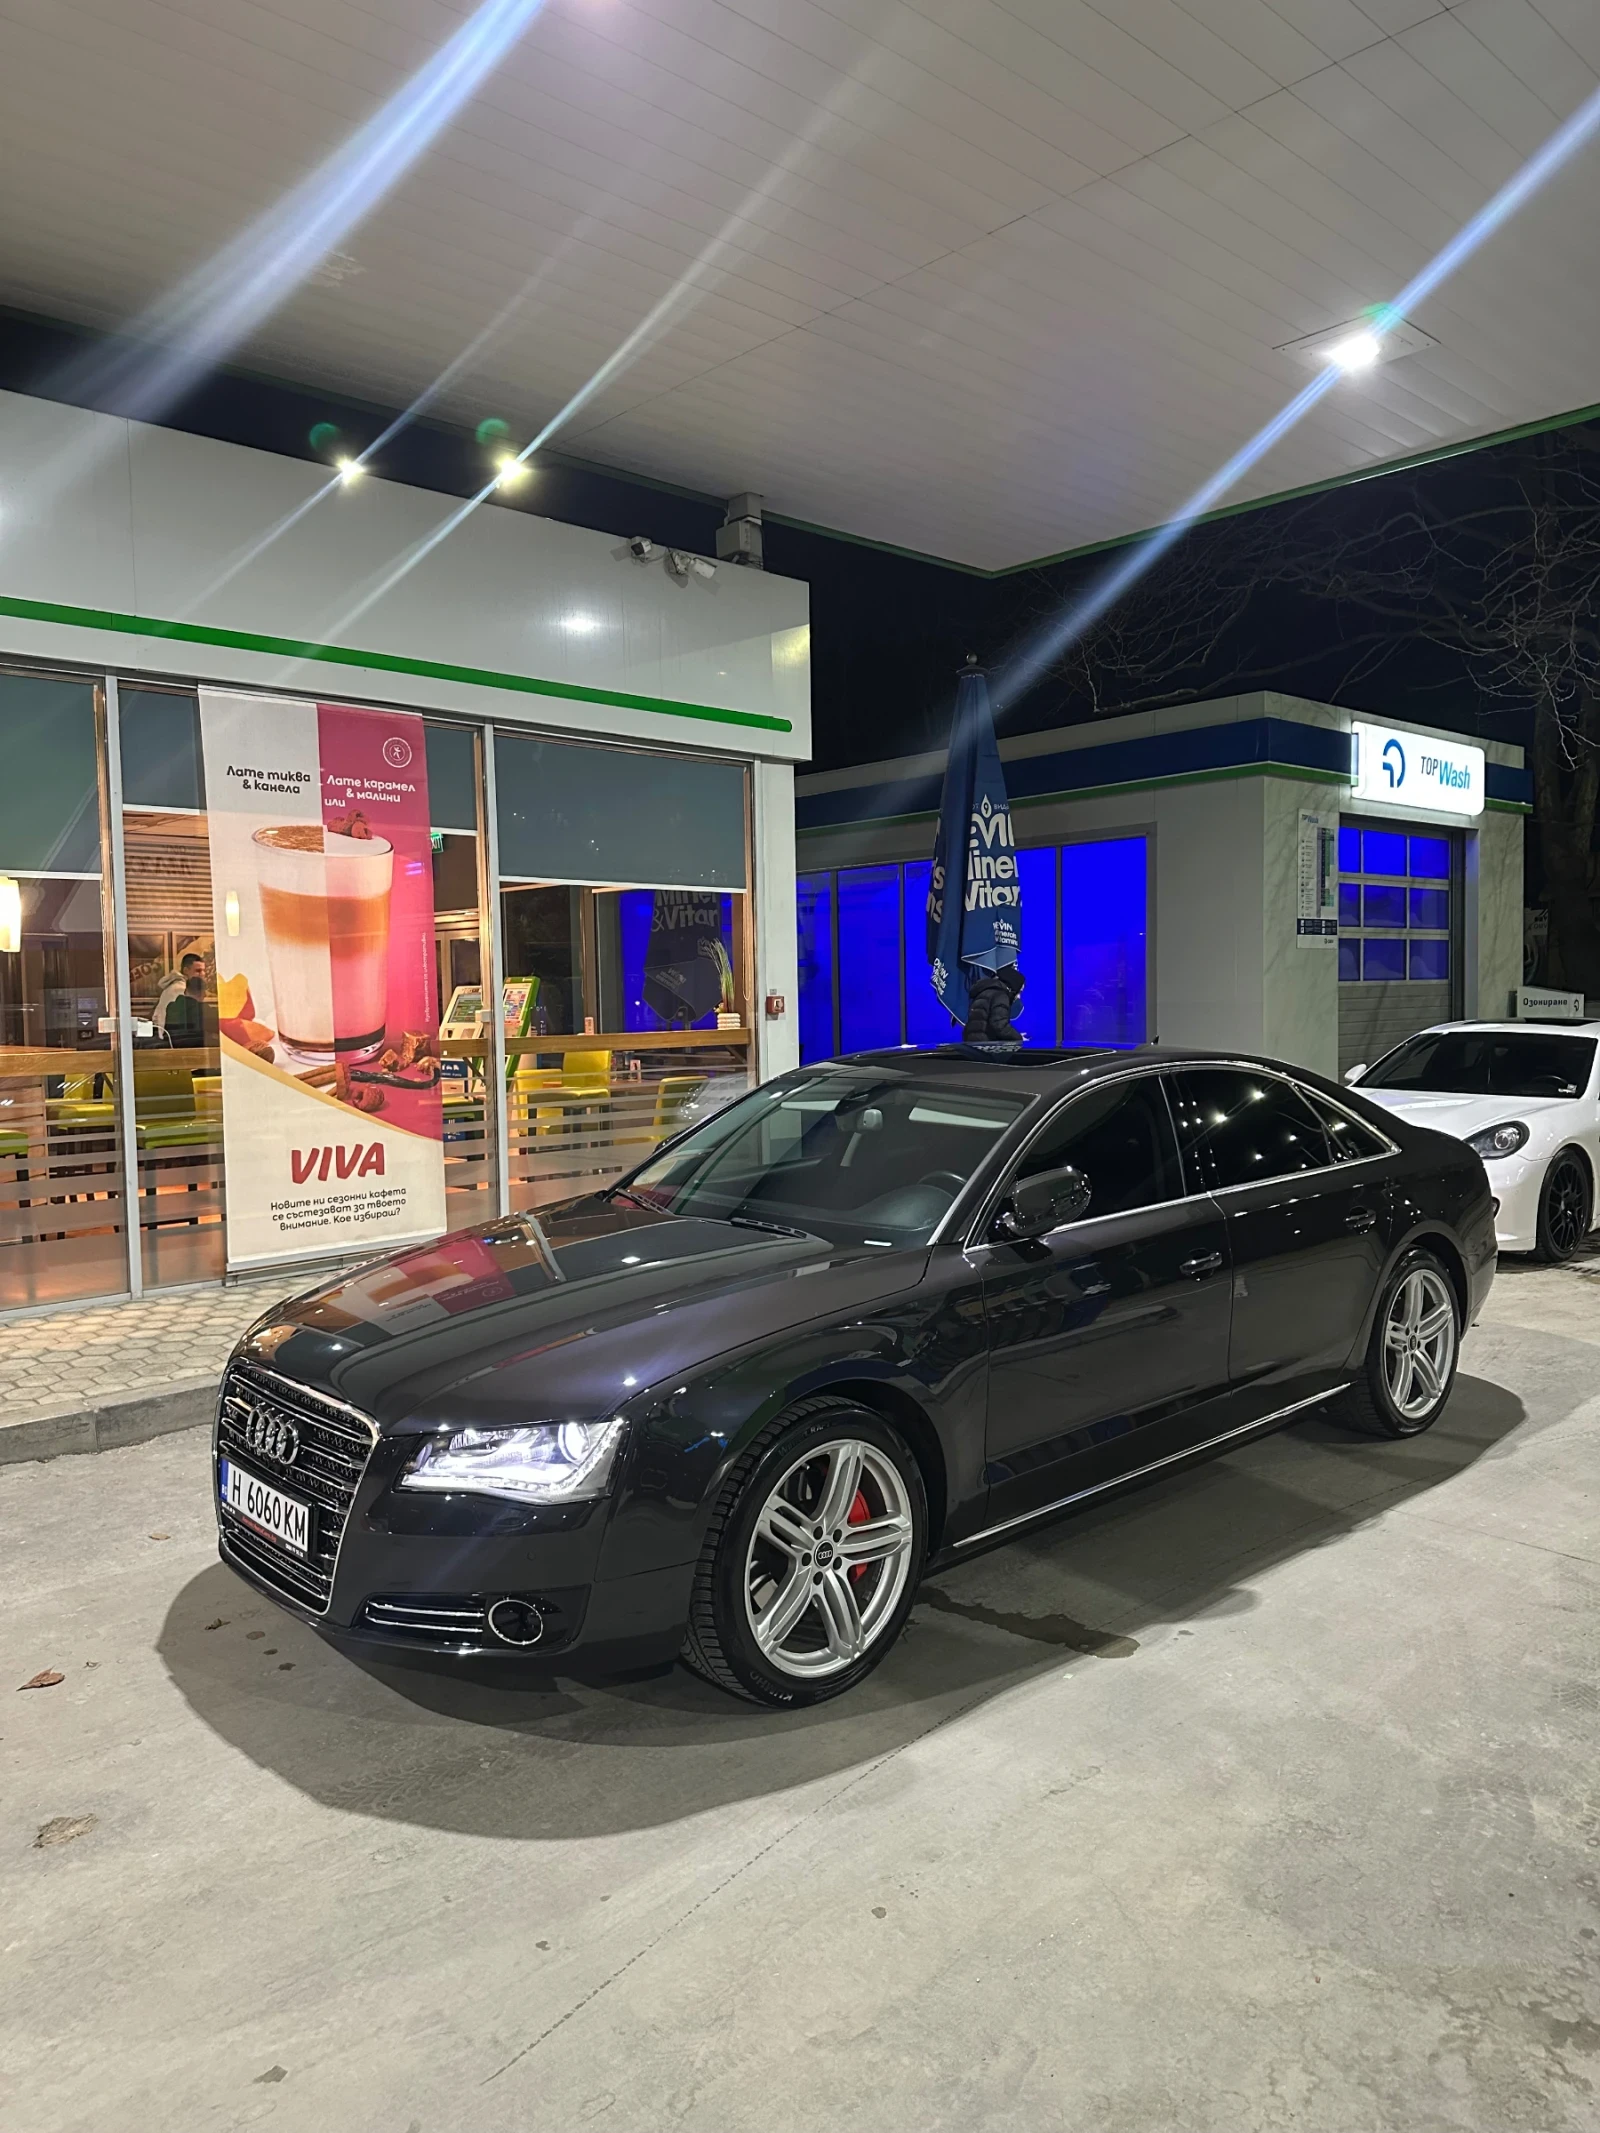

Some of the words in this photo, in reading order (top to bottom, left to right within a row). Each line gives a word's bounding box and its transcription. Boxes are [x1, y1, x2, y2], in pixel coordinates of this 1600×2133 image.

[226, 765, 264, 779] Лате
[267, 771, 311, 782] тиква
[326, 775, 361, 788] Лате
[364, 779, 416, 793] карамел
[1421, 756, 1438, 776] TOP
[1439, 760, 1471, 789] Wash
[242, 779, 252, 790] &
[254, 780, 301, 794] канела
[346, 787, 354, 798] &
[357, 790, 401, 803] малини
[324, 798, 346, 808] или
[291, 1142, 385, 1184] VIVA
[270, 1200, 311, 1211] Новите
[313, 1198, 325, 1206] ни
[327, 1193, 367, 1204] сезонни
[369, 1187, 407, 1200] кафета
[272, 1213, 284, 1221] се
[286, 1206, 352, 1220] състезават
[354, 1203, 365, 1212] за
[367, 1198, 407, 1209] твоето
[280, 1219, 332, 1231] внимание.
[333, 1214, 351, 1224] Кое
[353, 1207, 401, 1222] избираш?
[232, 1469, 242, 1506] H
[247, 1481, 282, 1530] 6060
[284, 1501, 306, 1546] KM
